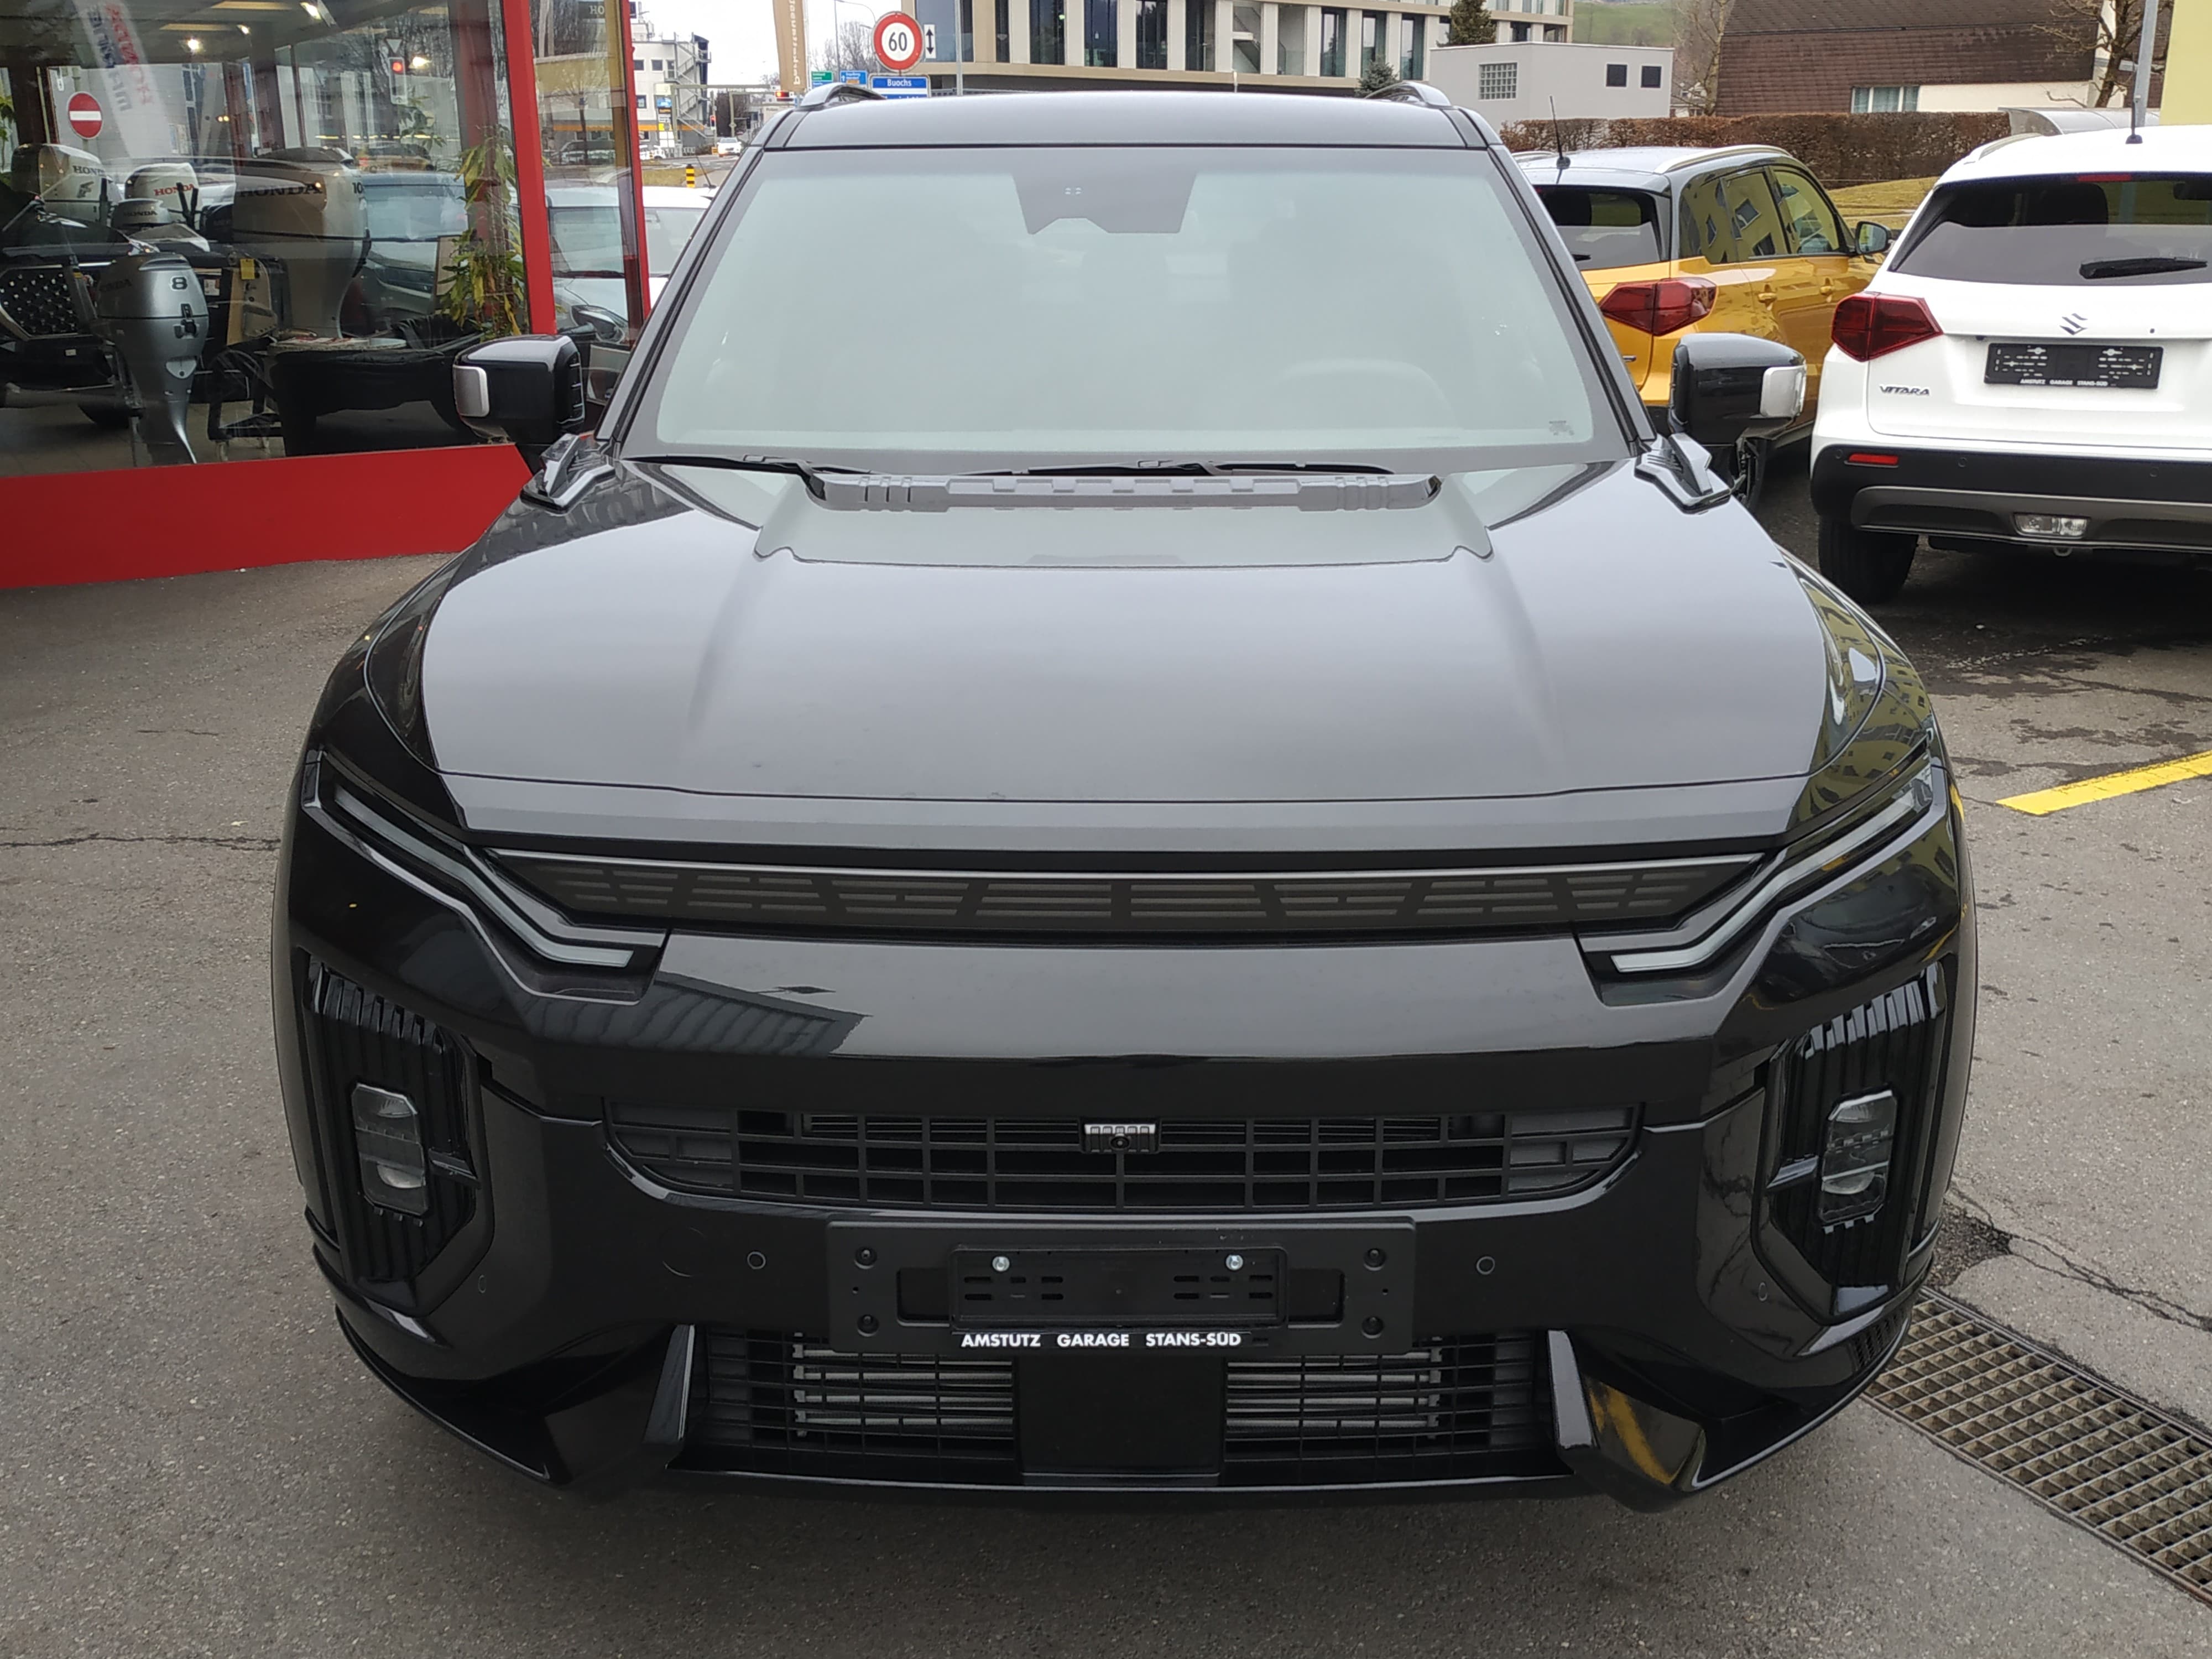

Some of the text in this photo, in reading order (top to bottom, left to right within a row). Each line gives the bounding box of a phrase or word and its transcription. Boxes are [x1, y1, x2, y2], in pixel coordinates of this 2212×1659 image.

[889, 32, 907, 51] 60
[887, 78, 912, 86] Buochs
[72, 165, 106, 176] HOND
[171, 276, 188, 291] 8
[1879, 385, 1929, 395] VITARA
[961, 1332, 1241, 1348] AMSTUTZ GARAGE STANS-SÜD
